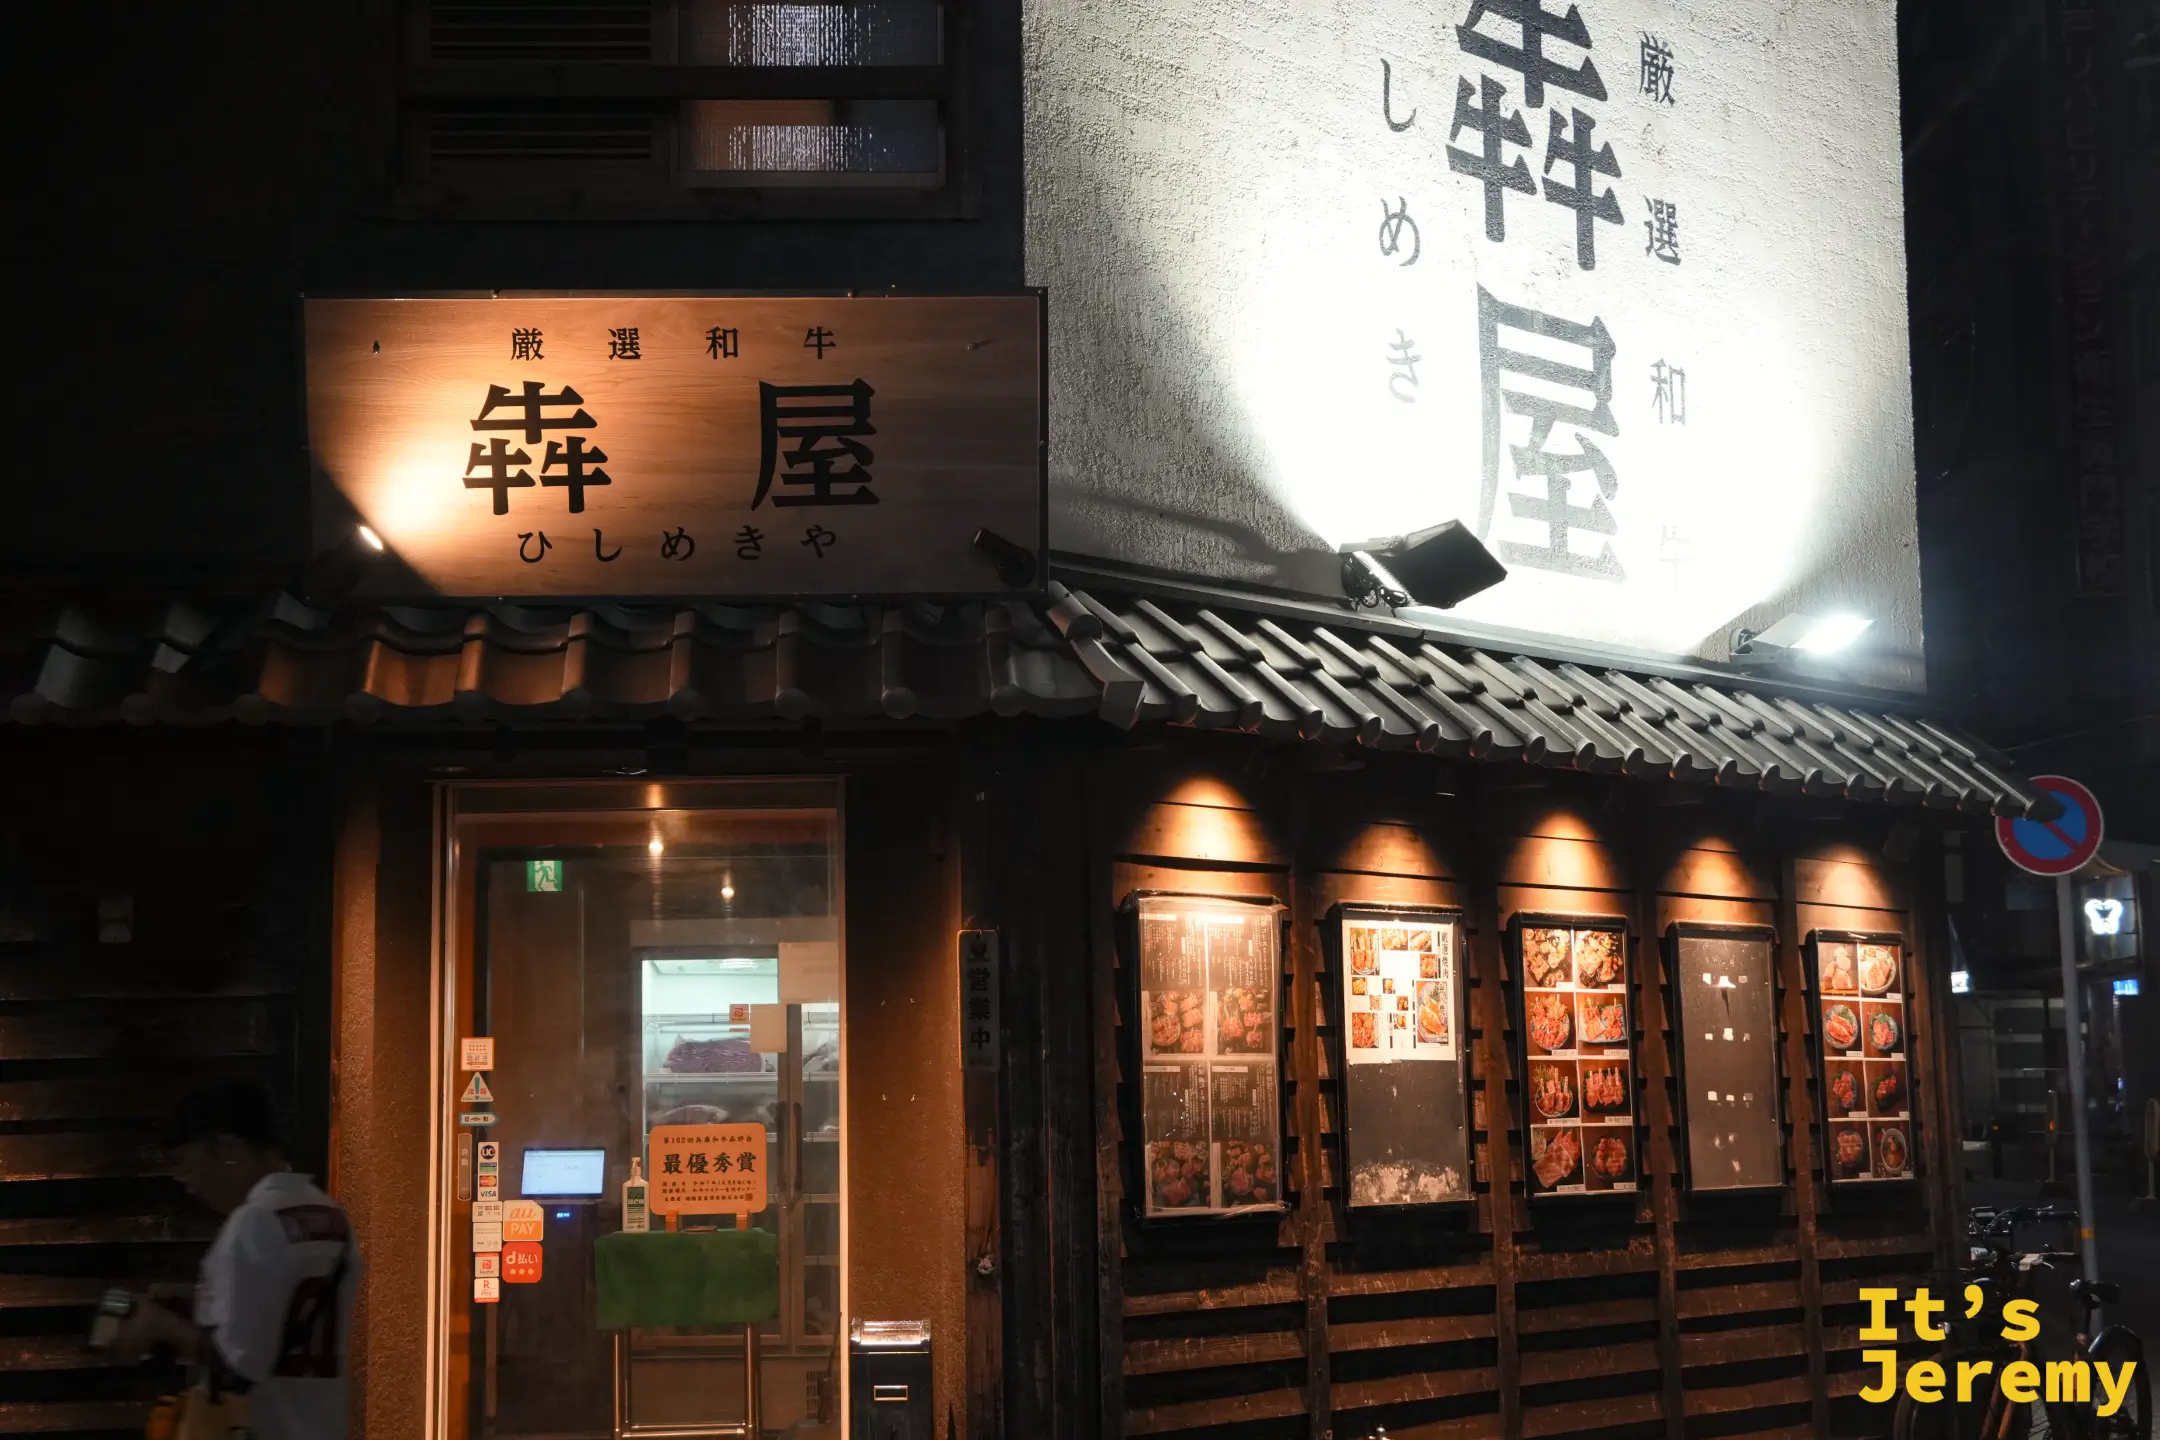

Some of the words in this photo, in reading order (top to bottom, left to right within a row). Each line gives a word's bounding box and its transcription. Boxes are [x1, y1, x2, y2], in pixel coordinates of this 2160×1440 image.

[510, 327, 837, 361] 厳選和牛
[462, 378, 880, 516] 犇屋
[517, 526, 837, 563] ひしめきや
[662, 1152, 757, 1175] 最優秀賞
[510, 1208, 537, 1218] au
[511, 1223, 535, 1235] PAY
[506, 1251, 538, 1265] d払い
[483, 1280, 490, 1289] R
